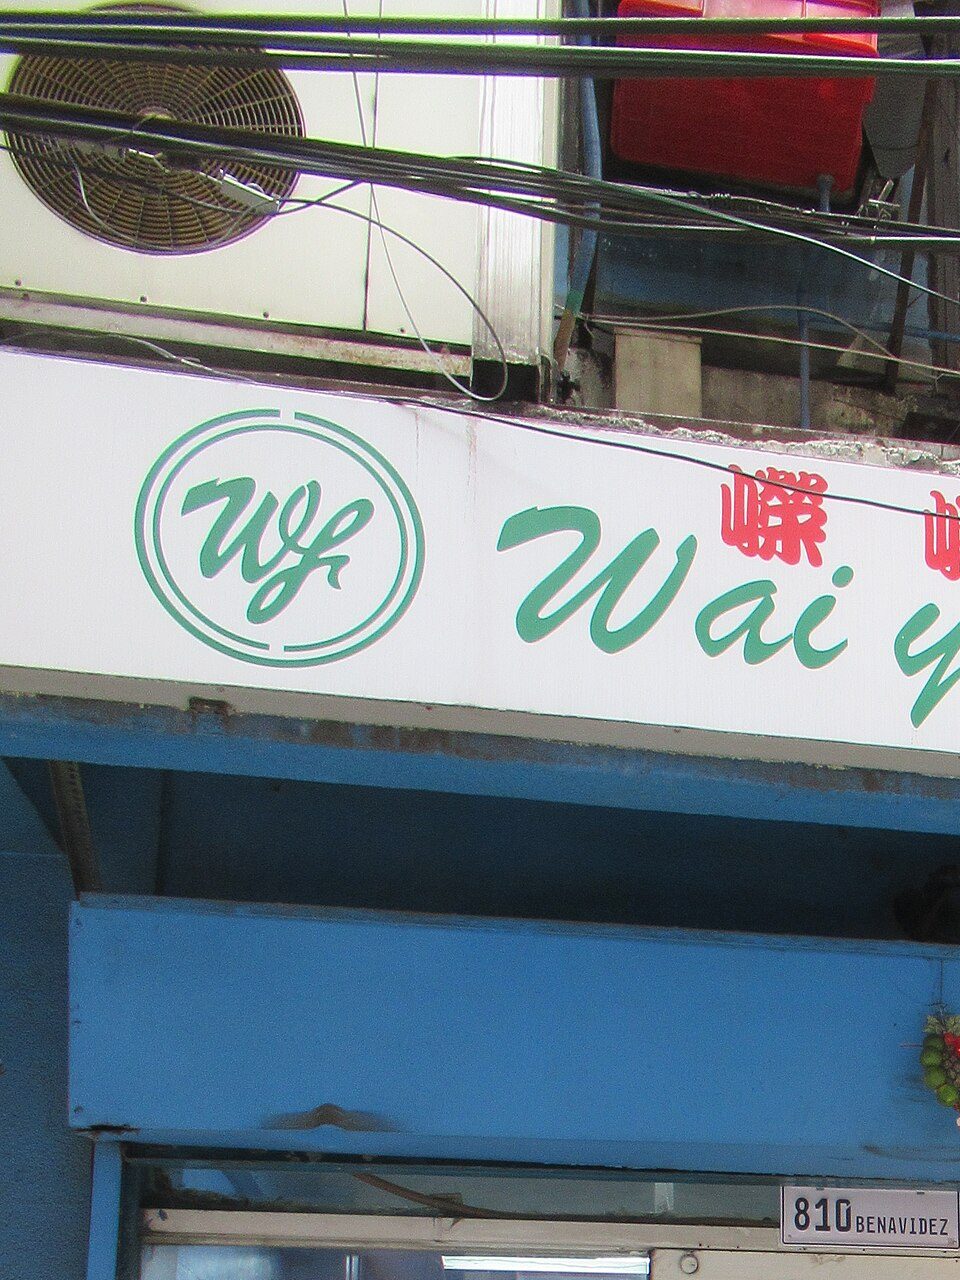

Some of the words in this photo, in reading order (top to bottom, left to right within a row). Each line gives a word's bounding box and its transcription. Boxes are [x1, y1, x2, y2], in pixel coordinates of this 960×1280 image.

[496, 505, 849, 670] Wai
[794, 1197, 852, 1233] 810
[856, 1215, 949, 1236] BENAVIDEZ
